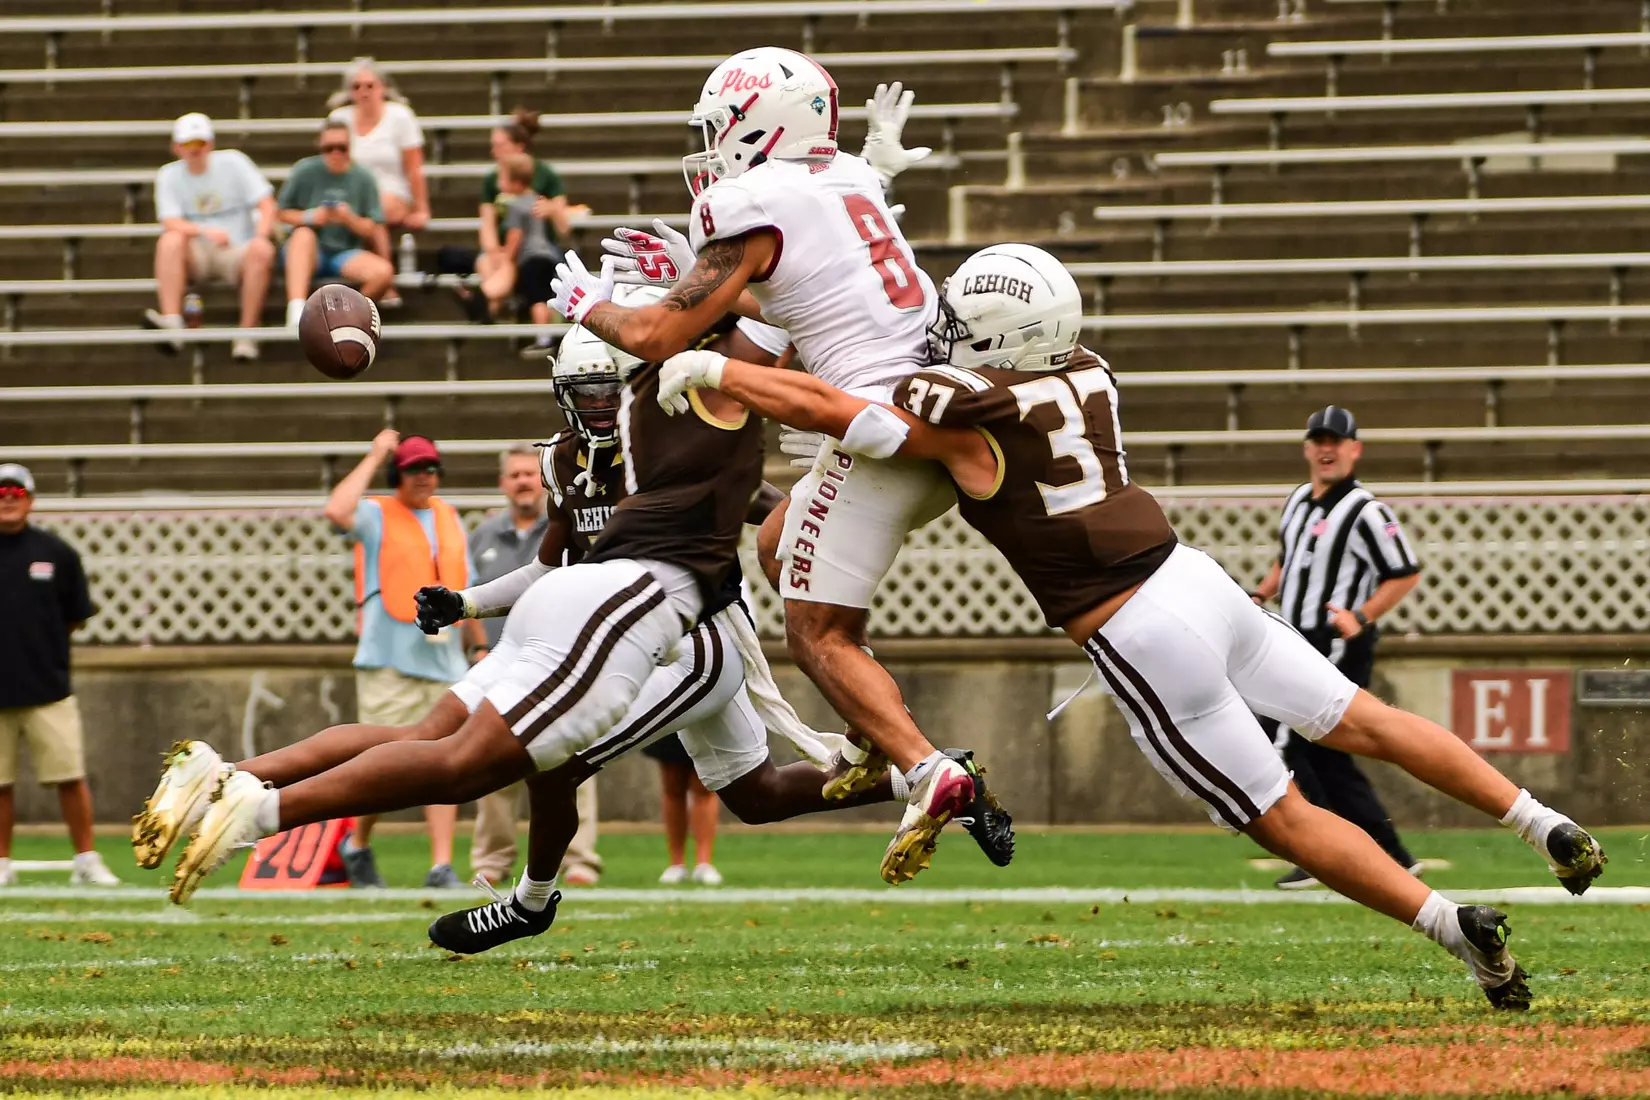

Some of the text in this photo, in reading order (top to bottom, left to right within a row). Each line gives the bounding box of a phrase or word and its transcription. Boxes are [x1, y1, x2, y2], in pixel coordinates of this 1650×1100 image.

[720, 68, 772, 96] Pios
[700, 202, 716, 237] 8
[842, 193, 925, 310] 8
[963, 274, 1034, 304] LEHIGH
[903, 377, 956, 424] 37
[1008, 366, 1129, 516] 37
[790, 448, 853, 593] PIONEERS
[253, 820, 327, 878] 20
